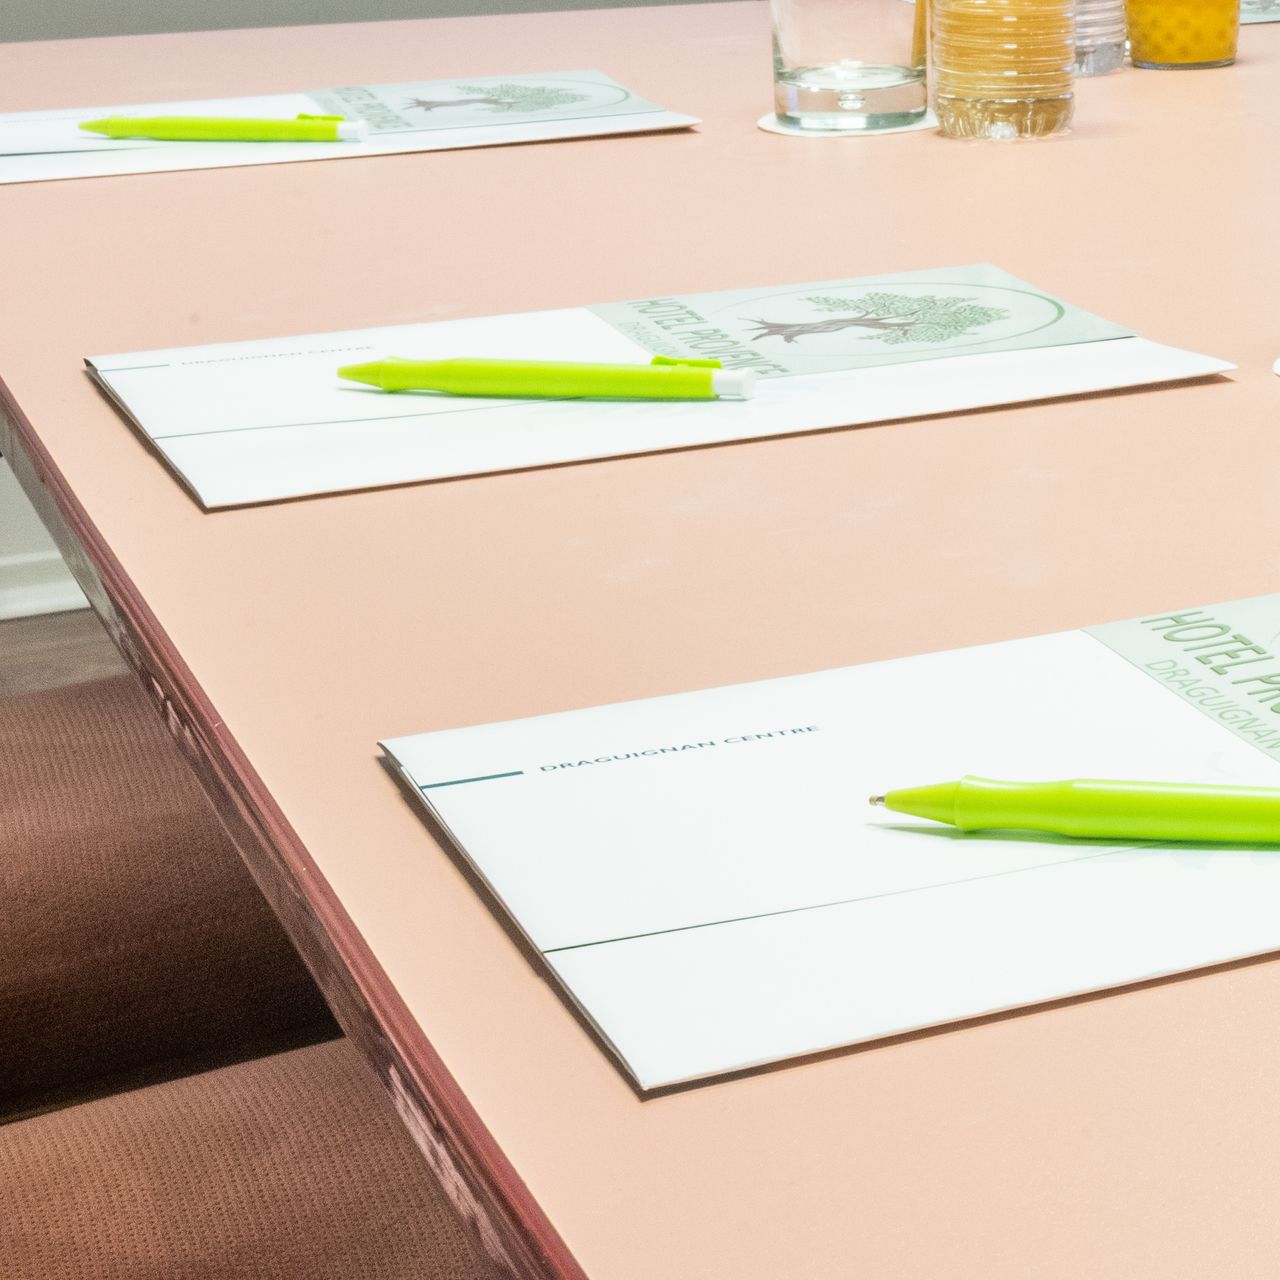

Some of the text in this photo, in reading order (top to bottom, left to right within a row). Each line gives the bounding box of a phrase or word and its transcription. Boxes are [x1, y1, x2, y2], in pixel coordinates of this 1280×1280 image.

[627, 297, 709, 331] HOTEL
[1140, 610, 1275, 676] HOTEL
[539, 724, 822, 773] DRAGUIGNAN CENTRE
